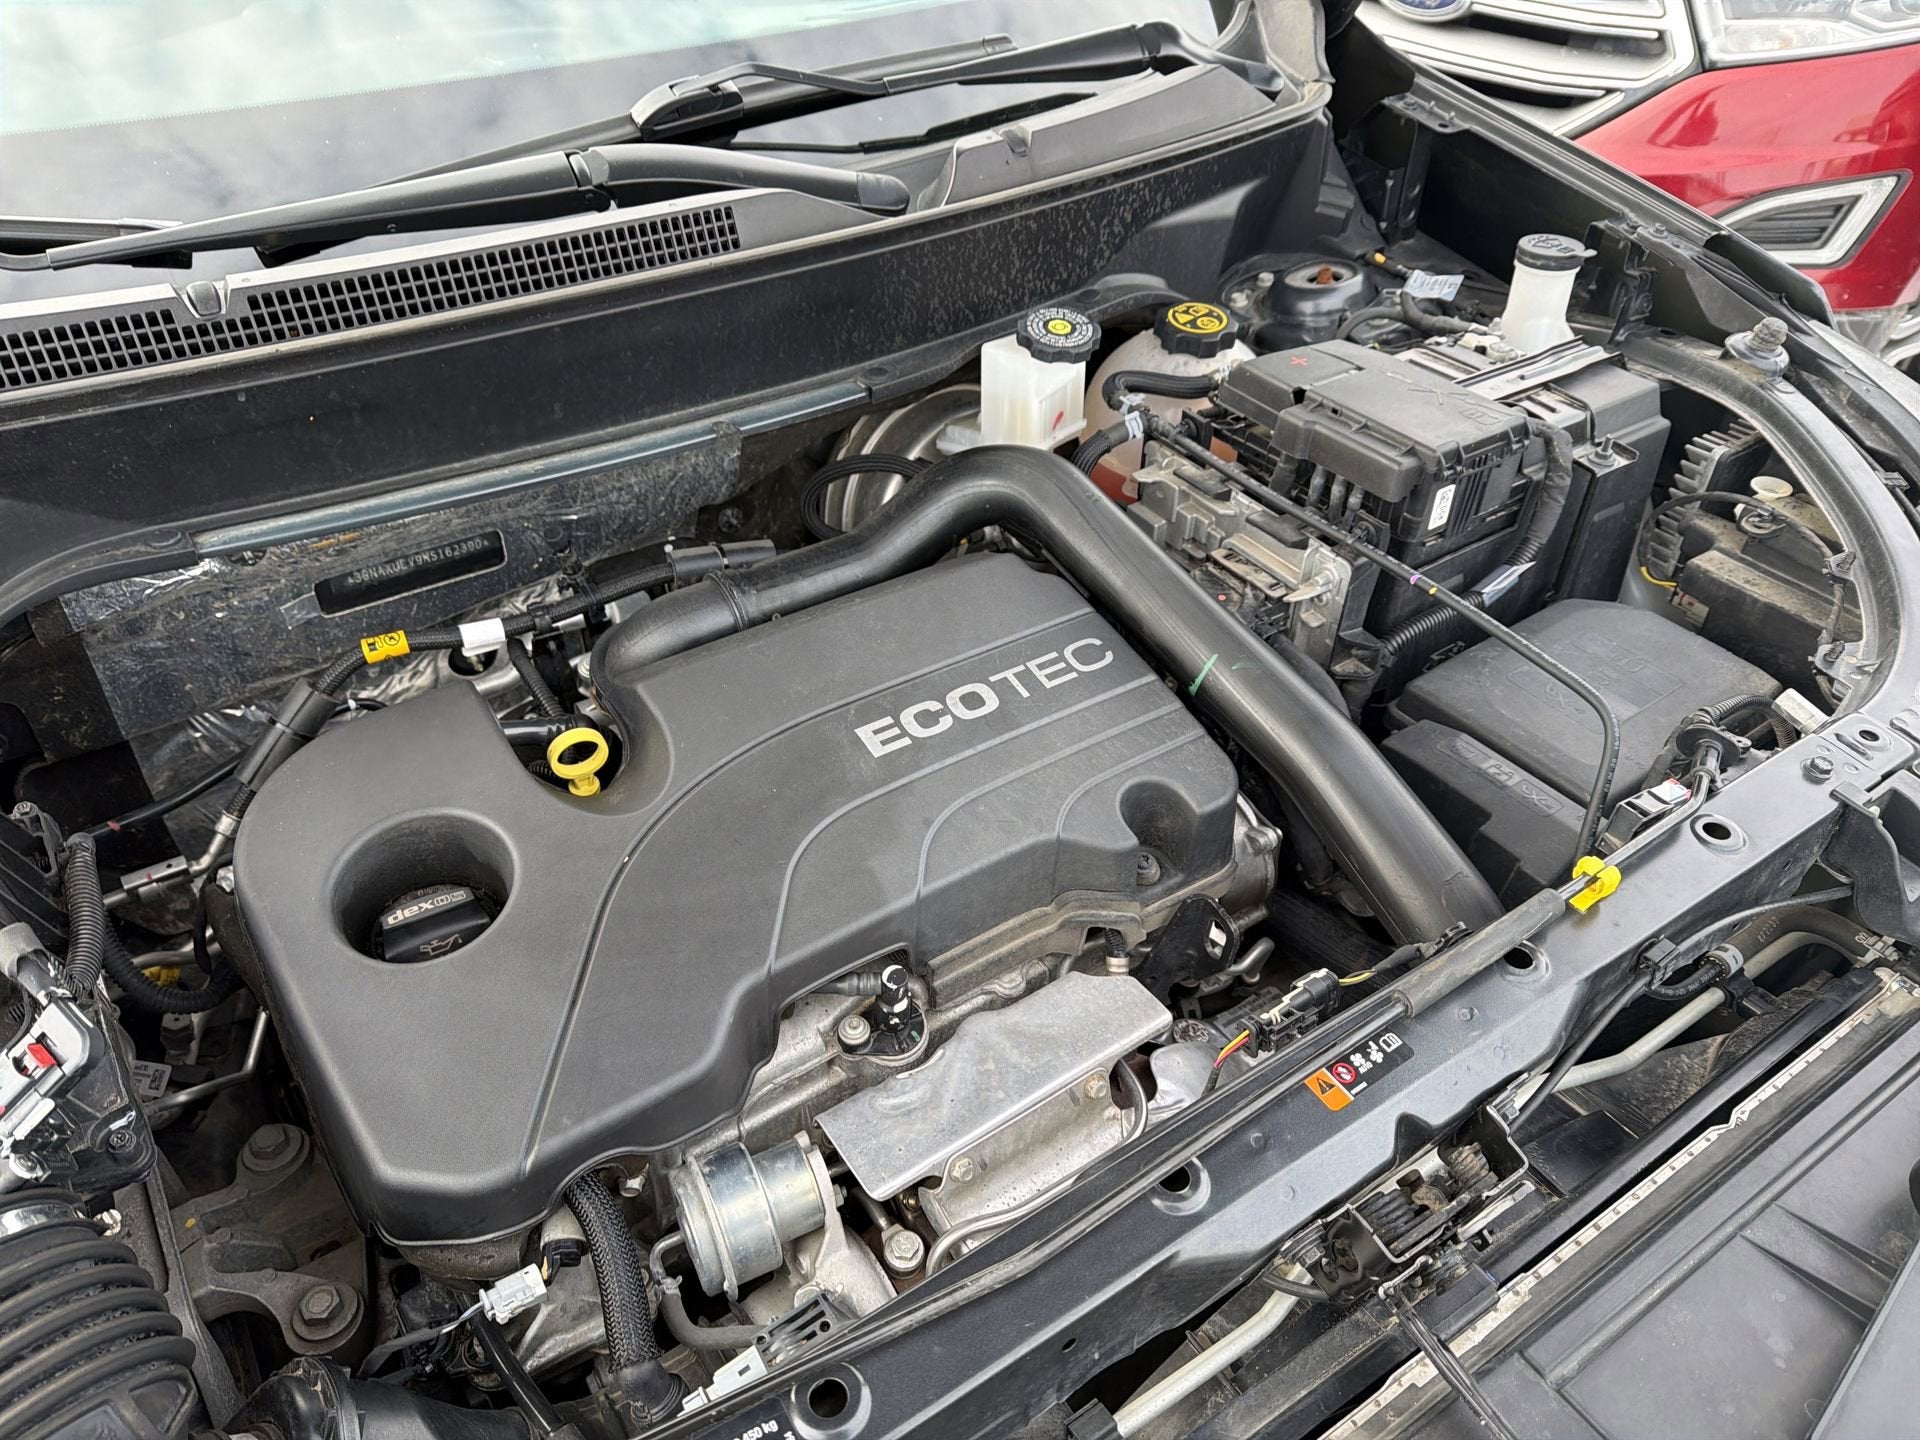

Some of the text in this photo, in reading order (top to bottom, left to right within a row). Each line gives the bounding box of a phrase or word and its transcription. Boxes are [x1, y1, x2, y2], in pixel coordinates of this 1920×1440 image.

[854, 637, 1114, 758] ECOTEC
[1358, 1062, 1373, 1074] AUTO
[762, 1420, 779, 1434] kg
